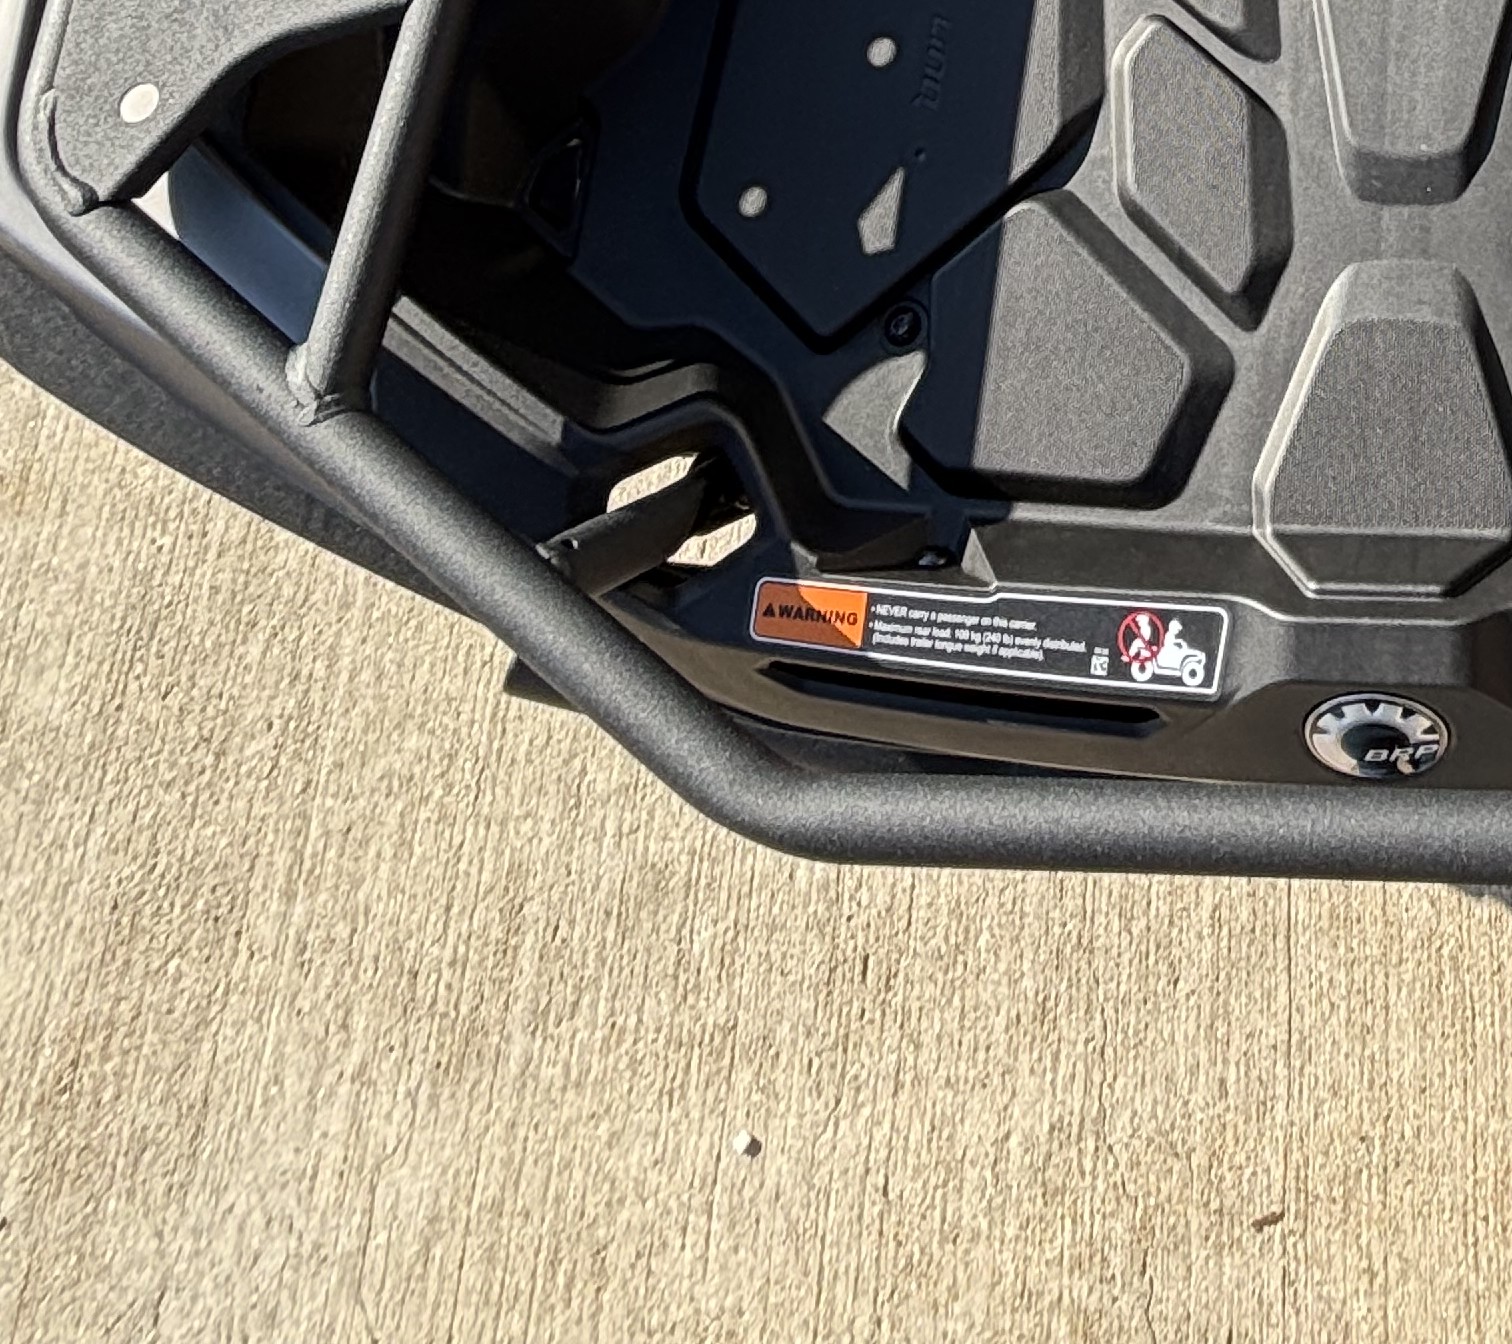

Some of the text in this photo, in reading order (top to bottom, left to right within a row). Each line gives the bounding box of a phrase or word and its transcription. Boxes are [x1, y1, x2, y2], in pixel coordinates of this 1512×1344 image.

[778, 603, 858, 626] WARNING
[876, 604, 908, 617] NEVER
[908, 609, 930, 622] carry
[937, 613, 980, 627] passenger
[1363, 743, 1441, 765] BRP
